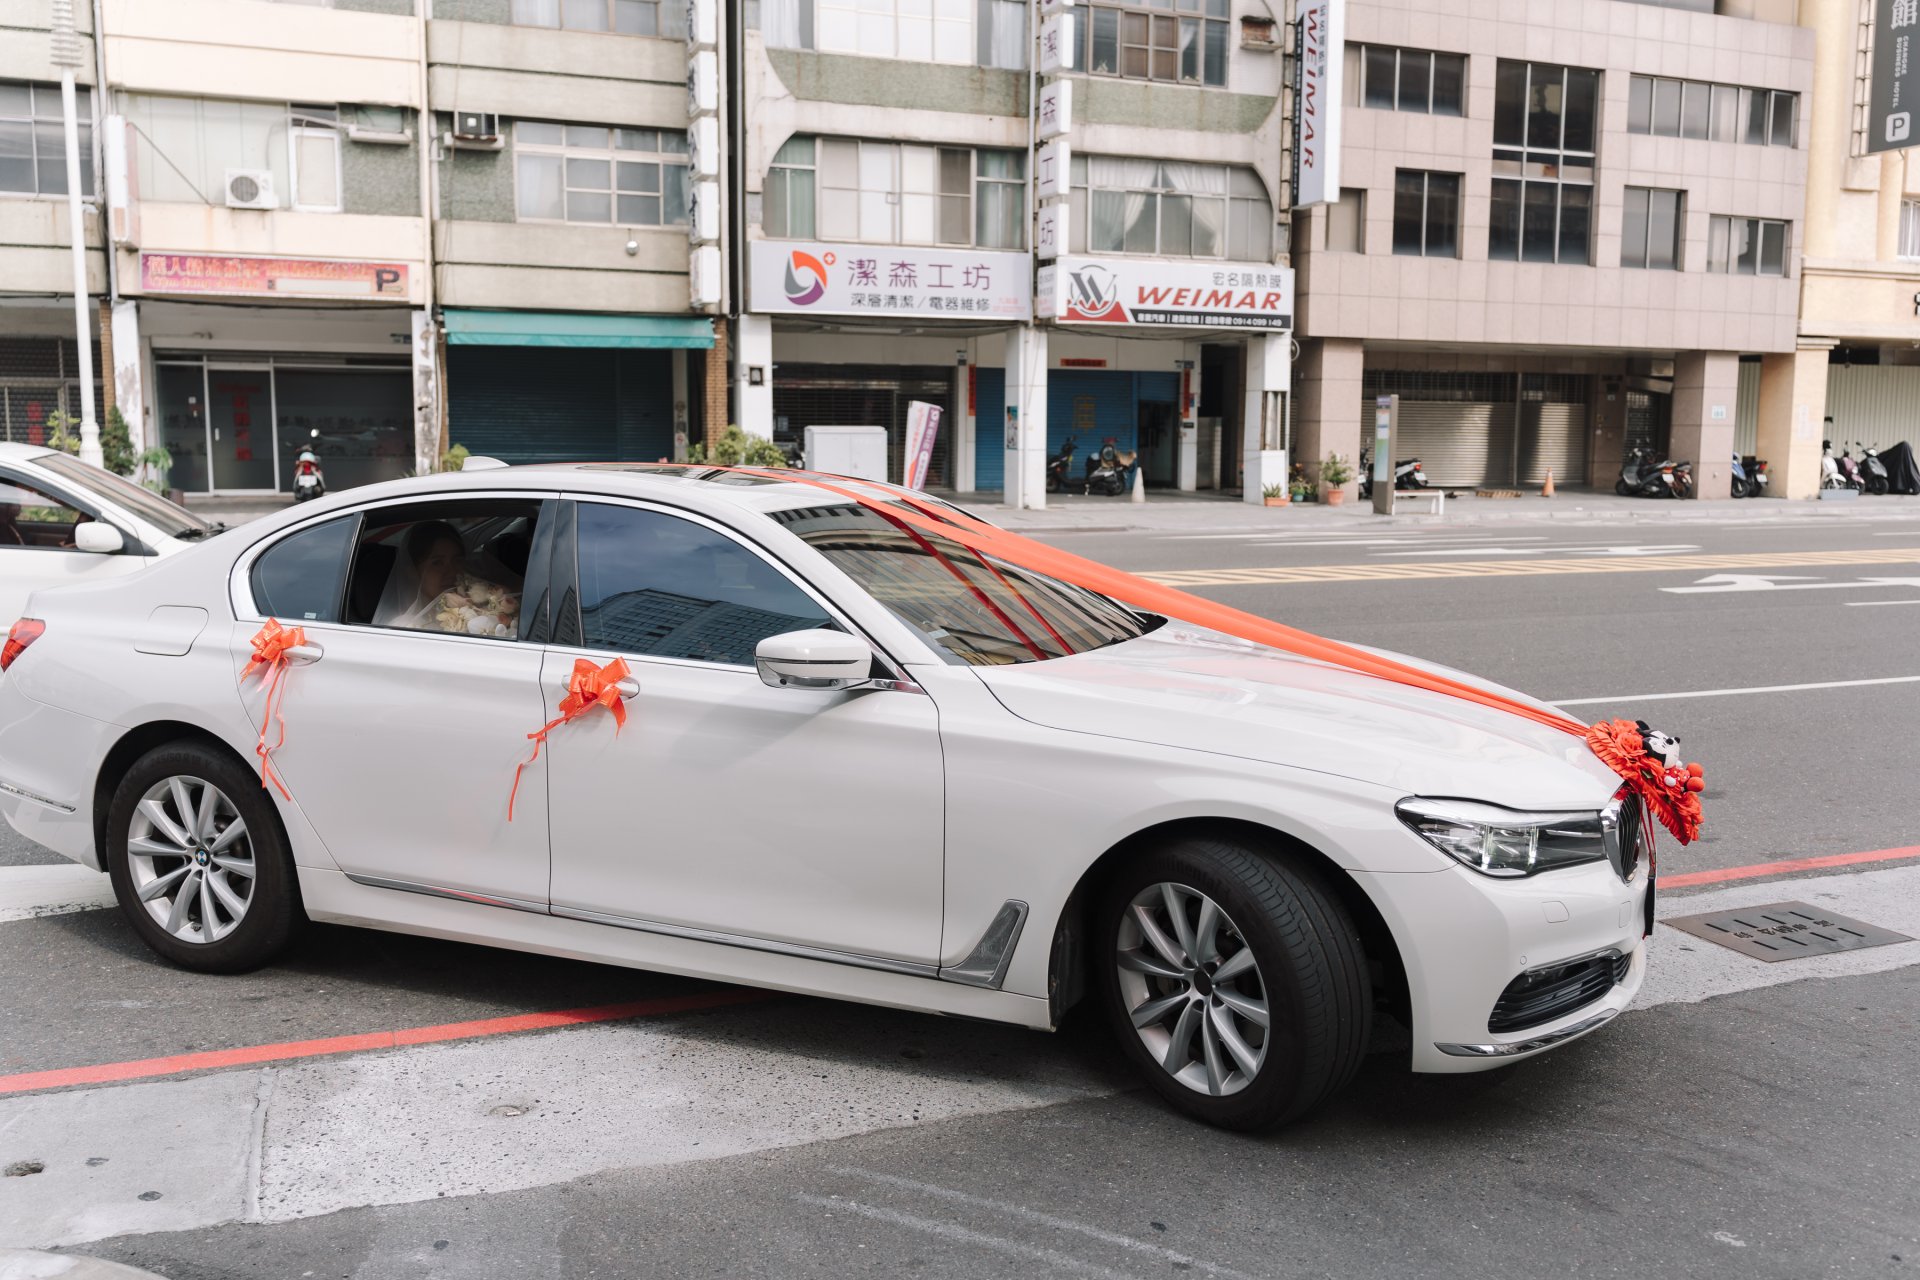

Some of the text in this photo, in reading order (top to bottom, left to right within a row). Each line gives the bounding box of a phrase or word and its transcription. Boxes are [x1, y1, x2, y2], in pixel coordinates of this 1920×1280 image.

[1304, 8, 1318, 169] WEIMAR
[1892, 117, 1905, 137] P
[375, 268, 400, 292] P
[847, 258, 991, 291] 潔森工坊
[1212, 271, 1282, 289] 宏名隔熱膜
[1138, 286, 1282, 311] WEIMAR
[1232, 317, 1252, 326] 0914
[1268, 319, 1283, 327] 149
